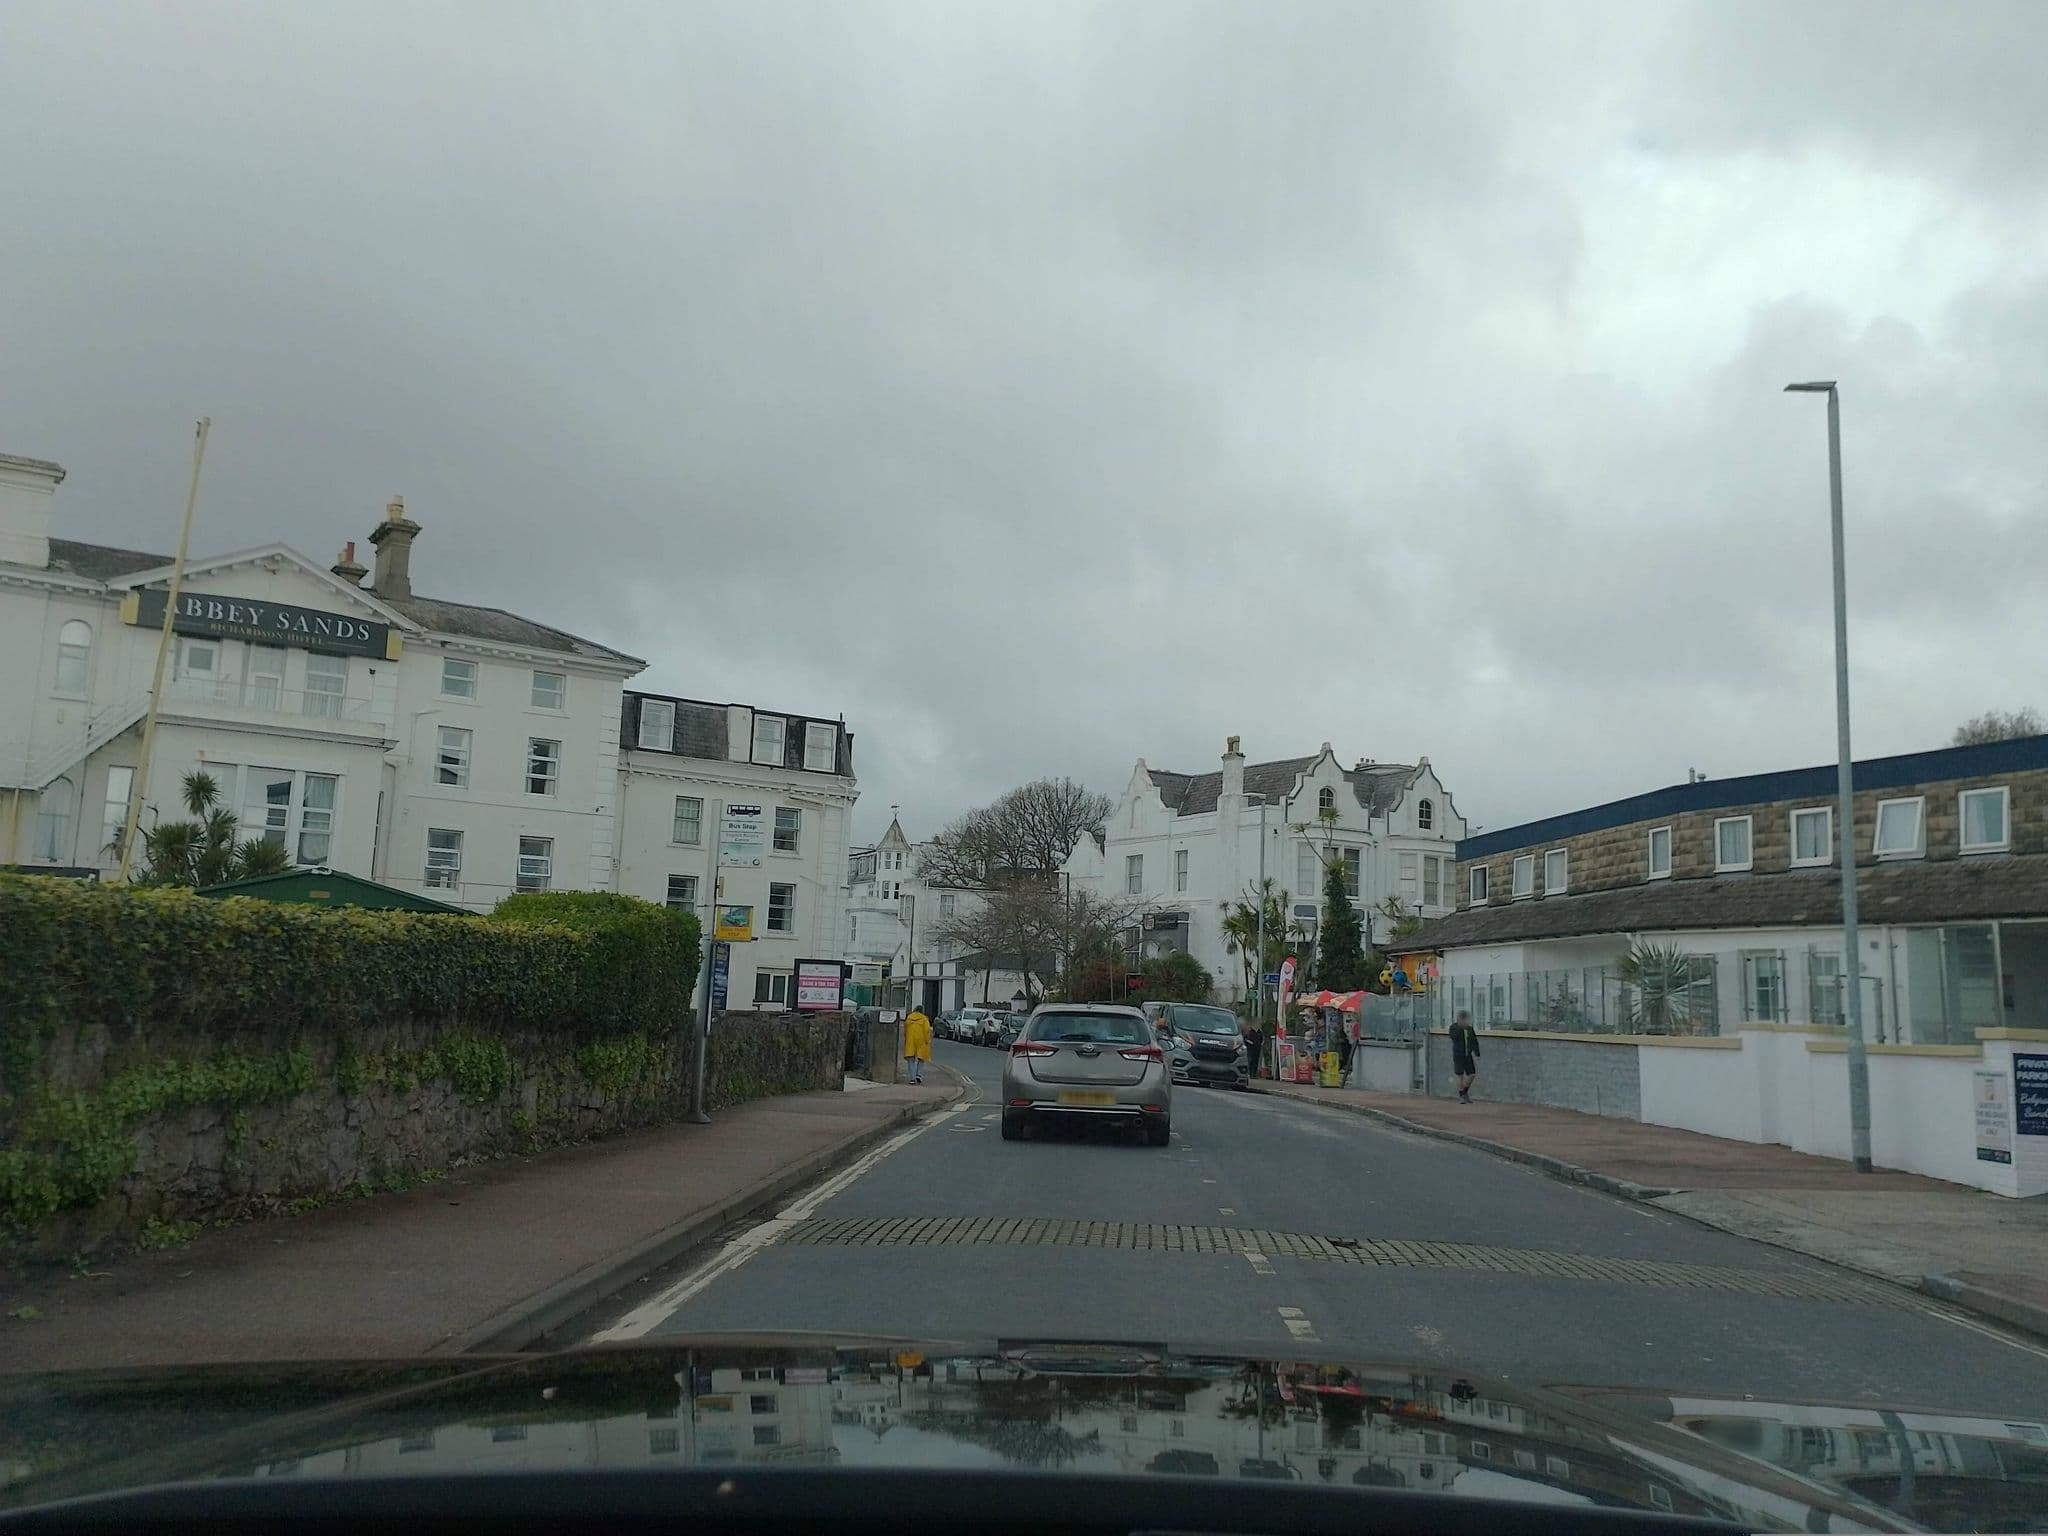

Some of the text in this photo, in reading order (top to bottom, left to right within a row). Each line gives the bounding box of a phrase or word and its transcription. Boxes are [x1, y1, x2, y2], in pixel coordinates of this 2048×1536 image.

[162, 597, 371, 642] ABBEY SANDS
[287, 632, 324, 646] HOTEL
[742, 823, 758, 831] Stop
